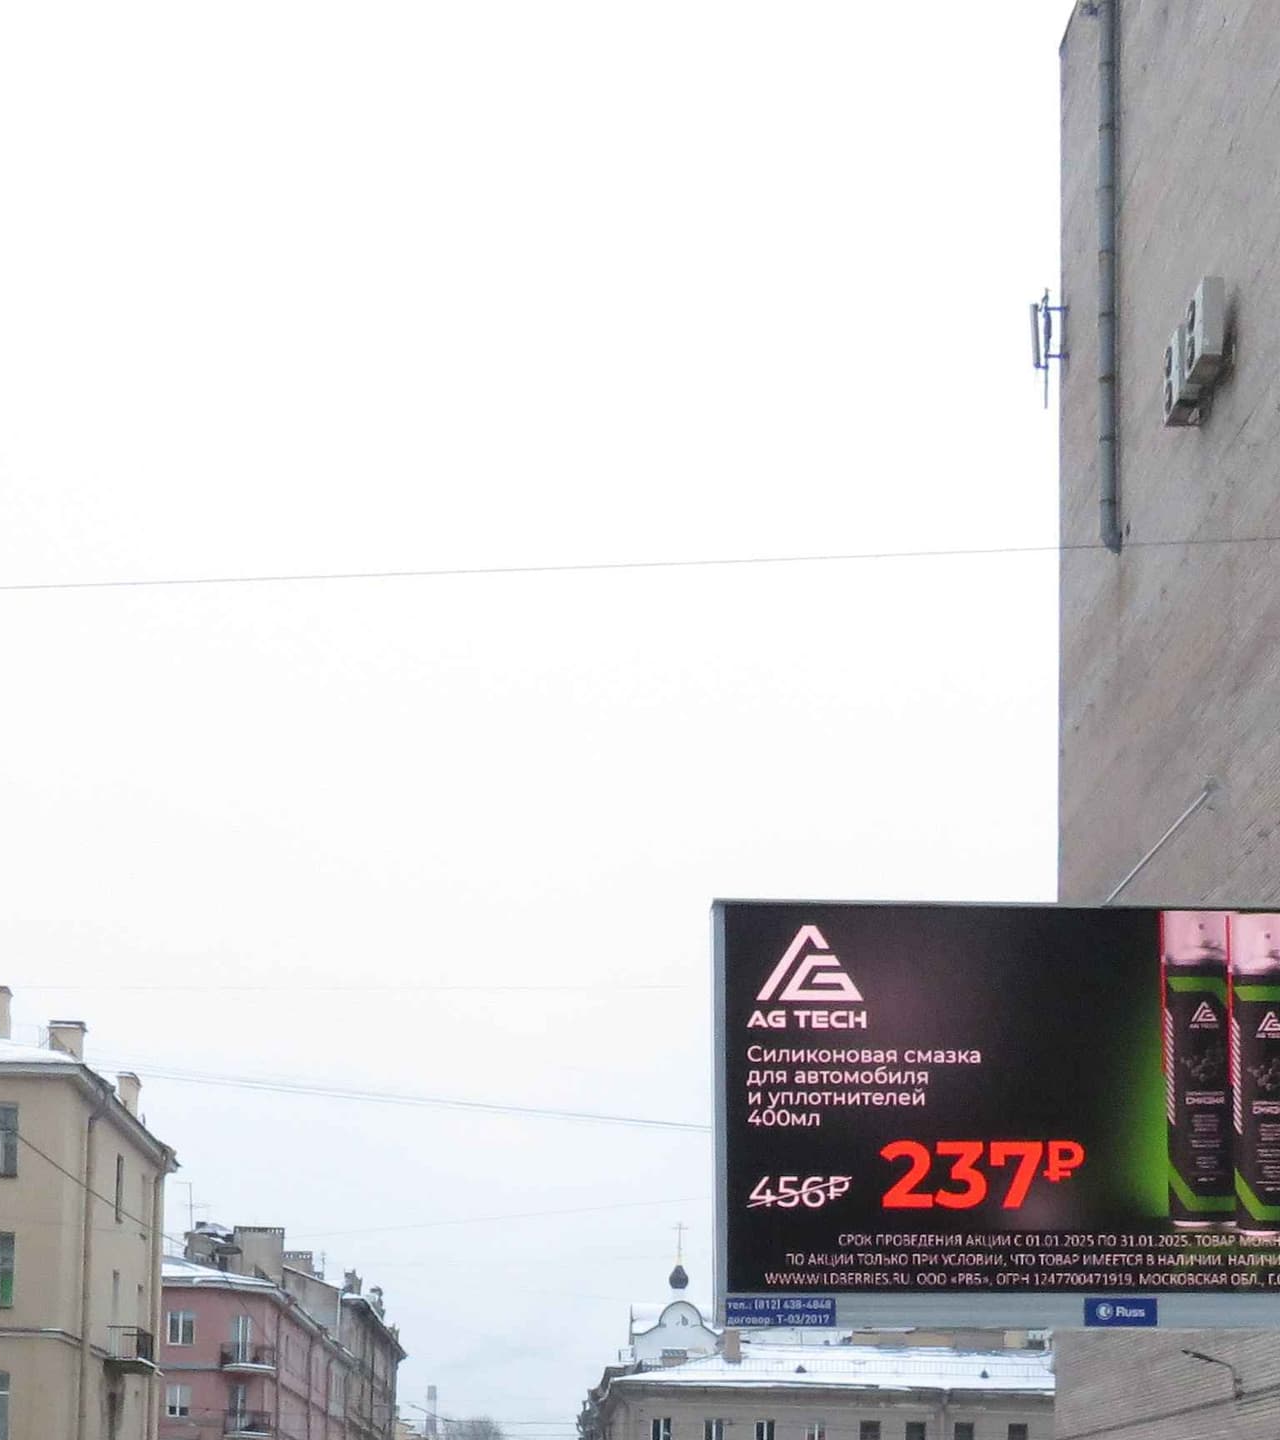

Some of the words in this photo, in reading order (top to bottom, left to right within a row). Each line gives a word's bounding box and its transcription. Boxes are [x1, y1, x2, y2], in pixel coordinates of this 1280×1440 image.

[747, 1010, 786, 1028] AG
[793, 1010, 867, 1028] TECH
[747, 1045, 897, 1064] Силиконовая
[904, 1049, 982, 1064] смазка
[747, 1069, 787, 1086] для
[794, 1066, 929, 1084] автомобиля
[748, 1092, 761, 1105] и
[768, 1088, 926, 1109] уплотнителей
[747, 1109, 821, 1127] 400мл
[880, 1139, 1085, 1209] 237₽
[838, 1234, 871, 1246] СРОК
[876, 1234, 962, 1248] ПРОВЕДЕНИЯ
[965, 1234, 1010, 1249] АКЦИИ
[1014, 1234, 1022, 1247] С
[1025, 1234, 1094, 1247] 01.01.2025
[1098, 1234, 1116, 1247] ПО
[1195, 1234, 1235, 1247] ТОВАР
[786, 1253, 804, 1265] ПО
[808, 1253, 854, 1267] АКЦИИ
[858, 1253, 908, 1265] ТОЛЬКО
[912, 1253, 938, 1265] ПРИ
[942, 1253, 1007, 1267] УСЛОВИИ,
[1010, 1254, 1035, 1265] ЧТО
[1039, 1254, 1079, 1265] ТОВАР
[1083, 1254, 1143, 1265] ИМЕЕТСЯ
[1147, 1254, 1155, 1265] В
[917, 1273, 947, 1285] ООО
[996, 1273, 1030, 1285] ОГРН
[1139, 1273, 1228, 1285] МОСКОВСКАЯ
[1115, 1306, 1145, 1317] Russ
